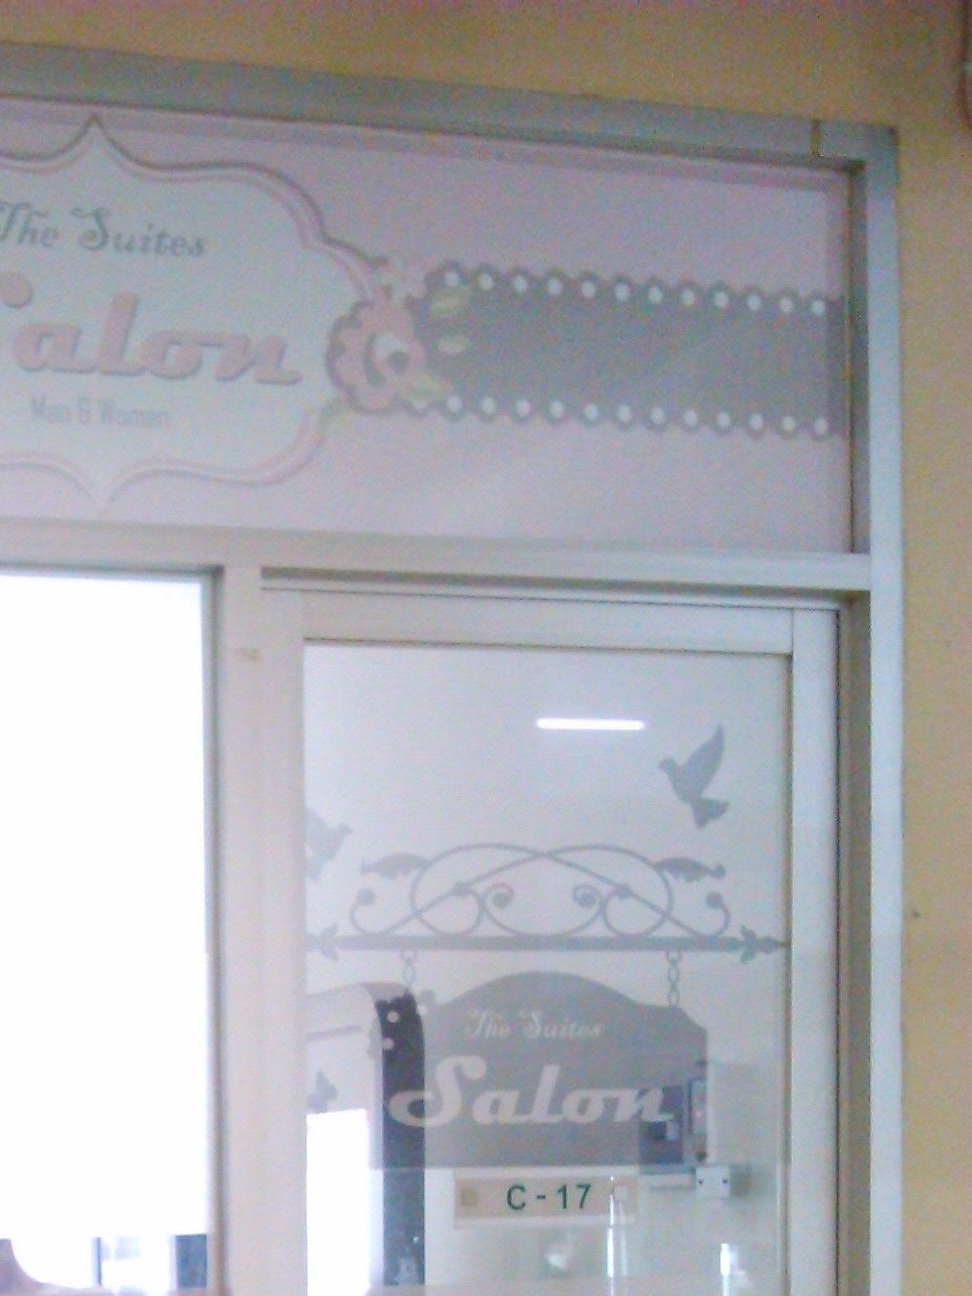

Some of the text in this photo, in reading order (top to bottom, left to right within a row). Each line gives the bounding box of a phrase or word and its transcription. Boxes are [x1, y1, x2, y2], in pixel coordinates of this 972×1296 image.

[69, 206, 206, 257] Suites
[465, 1009, 603, 1038] The Suites
[388, 1055, 676, 1127] Salon
